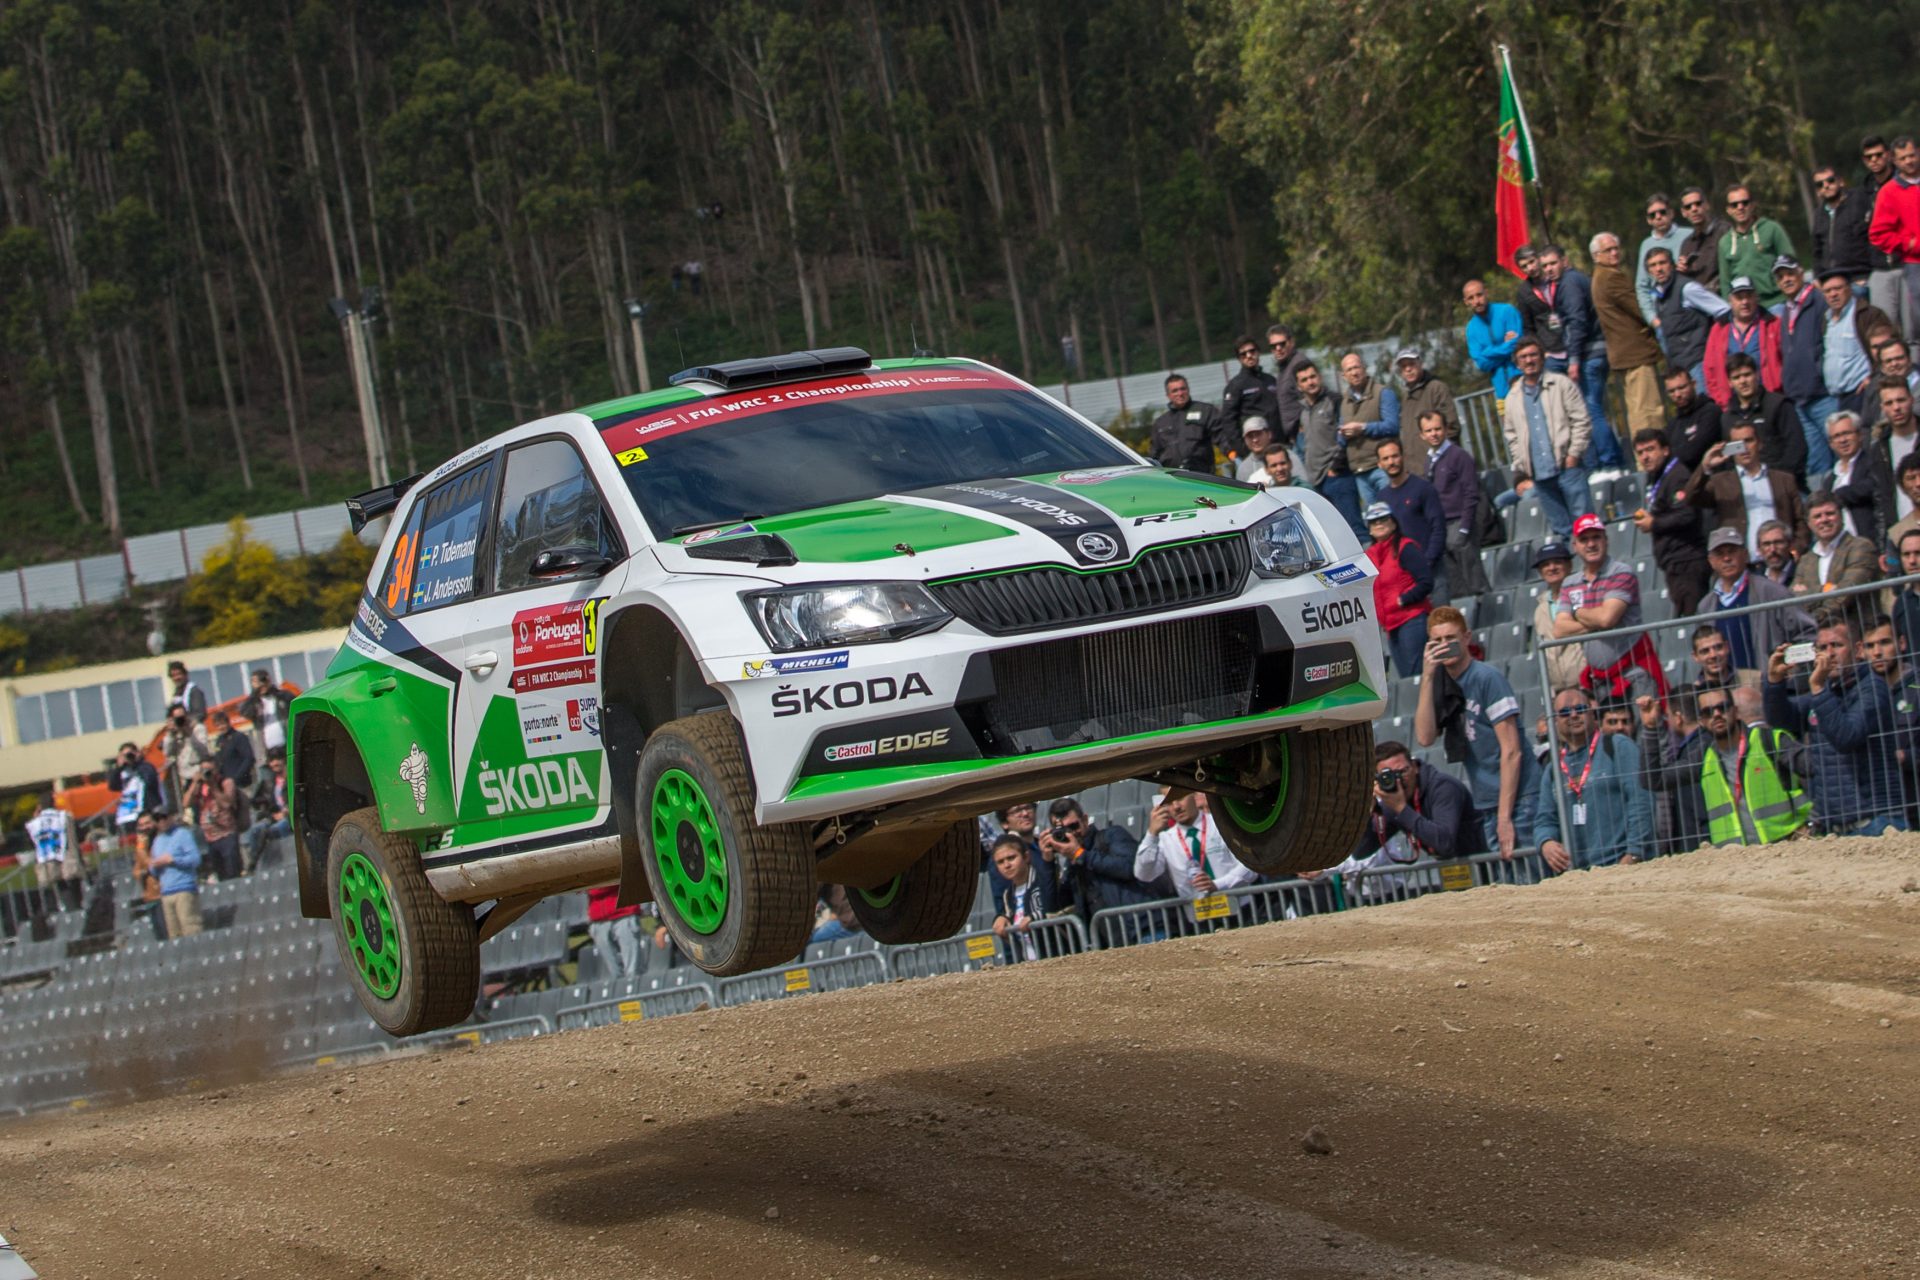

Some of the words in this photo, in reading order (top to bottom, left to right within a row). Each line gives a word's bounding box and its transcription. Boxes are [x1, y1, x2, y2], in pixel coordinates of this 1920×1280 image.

[689, 407, 722, 420] FIA
[722, 397, 767, 413] WRC
[768, 393, 783, 403] 2
[785, 378, 911, 399] Championship
[626, 452, 640, 463] 2
[1010, 496, 1088, 525] ŠKODA
[1133, 510, 1198, 527] R5
[431, 545, 439, 566] P.
[440, 533, 477, 564] Tidemand
[387, 530, 419, 609] 34
[1331, 567, 1360, 580] MICHELIN
[424, 581, 432, 603] J.
[432, 575, 473, 600] Andersson
[367, 609, 388, 641] EDGE
[584, 599, 607, 653] 3
[1301, 597, 1367, 633] ŠKODA
[535, 619, 581, 641] Portugal
[782, 655, 848, 669] MICHELIN
[1329, 659, 1353, 677] EDGE
[580, 697, 597, 711] SUPP
[771, 672, 933, 717] ŠKODA
[837, 742, 873, 758] Castrol
[877, 727, 950, 754] EDGE
[478, 757, 595, 816] ŠKODA
[426, 829, 455, 851] R5
